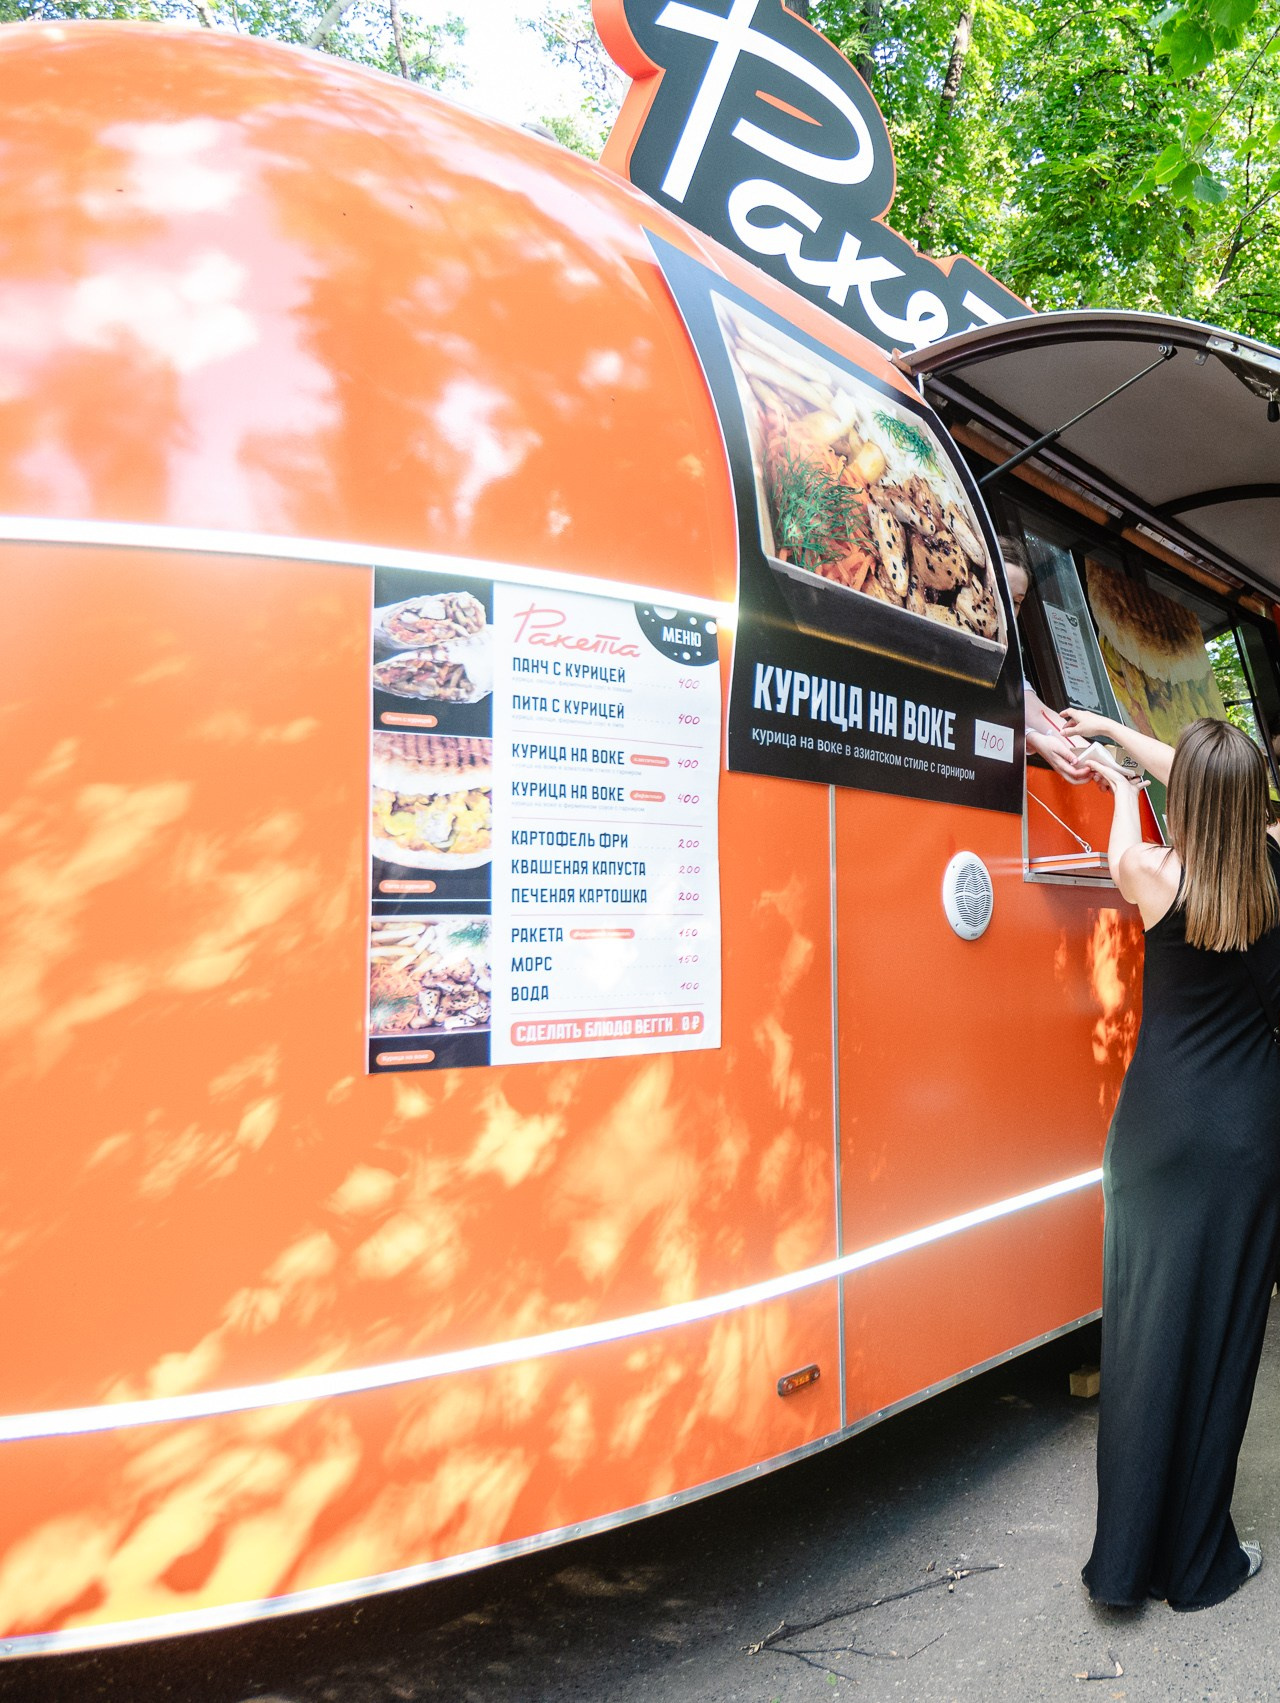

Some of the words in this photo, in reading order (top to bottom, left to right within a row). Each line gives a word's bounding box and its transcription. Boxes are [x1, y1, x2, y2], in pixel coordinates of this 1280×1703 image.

[654, 0, 1006, 350] Раке
[513, 602, 642, 658] Ракета
[662, 625, 702, 648] МЕНЮ
[512, 656, 549, 675] ПАНЧ
[553, 661, 562, 676] С
[565, 663, 626, 684] КУРИЦЕЙ
[512, 694, 548, 712] ПИТА
[552, 698, 560, 713] С
[564, 699, 625, 720] КУРИЦЕЙ
[678, 713, 701, 725] 400
[753, 662, 863, 733] КУРИЦА
[869, 690, 898, 738] НА
[903, 699, 957, 751] ВОКЕ
[981, 730, 1005, 752] 400
[511, 743, 567, 763] КУРИЦА
[571, 747, 588, 763] НА
[591, 749, 625, 765] ВОКЕ
[677, 758, 699, 769] 400
[752, 727, 797, 749] курица
[800, 736, 814, 750] на
[817, 739, 843, 755] воке
[845, 744, 852, 756] в
[853, 746, 901, 766] азиатском
[903, 756, 929, 772] стиле
[930, 762, 936, 772] с
[937, 763, 976, 781] гарниром
[511, 781, 567, 800] КУРИЦА
[571, 784, 588, 800] НА
[591, 786, 625, 802] ВОКЕ
[677, 794, 700, 804] 400
[511, 830, 595, 848] КАРТОФЕЛЬ
[599, 832, 629, 849] ФРИ
[678, 838, 700, 849] 200
[511, 859, 588, 875] КВАШЕНАЯ
[592, 860, 646, 876] КАПУСТА
[678, 865, 701, 875] 200
[511, 888, 575, 904] ПЕЧЕНАЯ
[579, 888, 648, 904] КАРТОШКА
[678, 892, 700, 902] 200
[511, 927, 564, 943] РАКЕТА
[511, 956, 553, 972] МОРС
[511, 985, 550, 1002] ВОДА
[516, 1024, 583, 1043] СДЕЛАТЬ
[585, 1019, 632, 1038] БЛЮДО
[635, 1016, 673, 1034] ВЕГГИ
